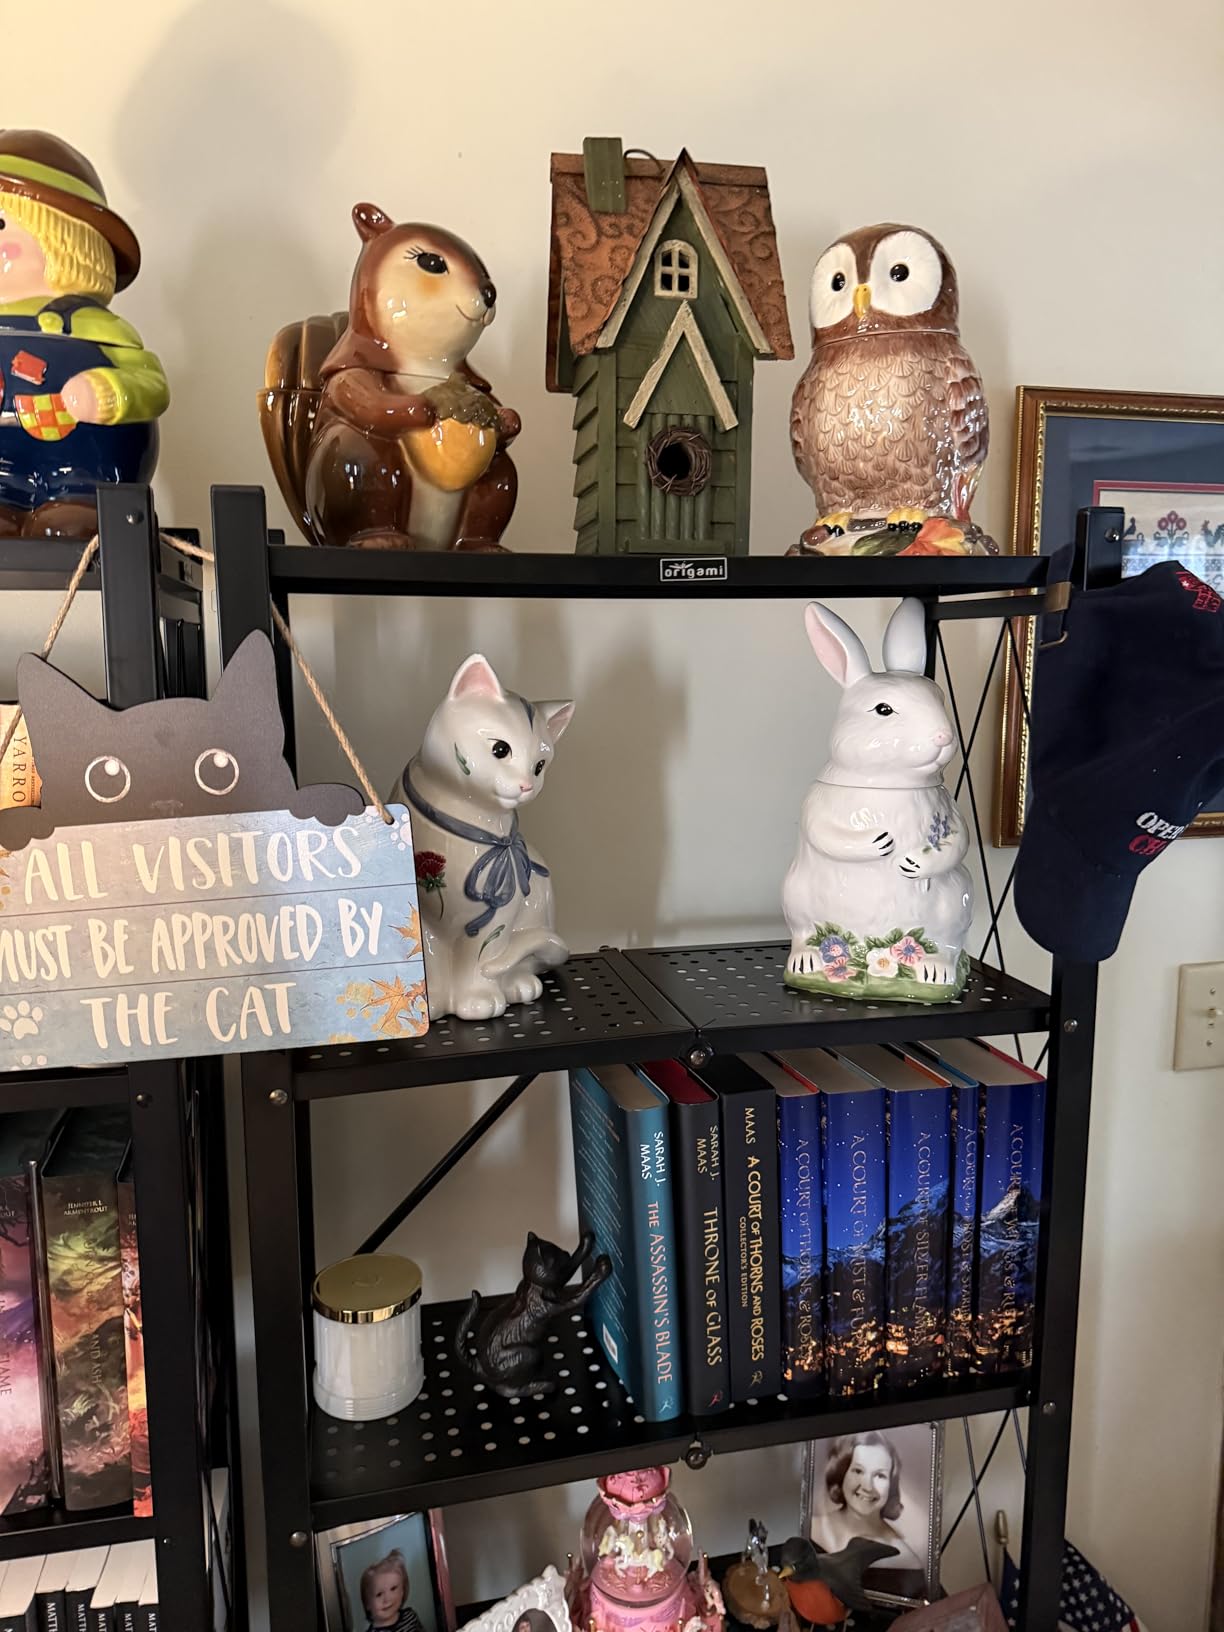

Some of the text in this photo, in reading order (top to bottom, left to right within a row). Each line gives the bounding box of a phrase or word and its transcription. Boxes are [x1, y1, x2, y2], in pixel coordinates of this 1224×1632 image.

[664, 562, 724, 579] origami
[25, 826, 362, 905] ALL VISITORS
[88, 918, 135, 979] BE
[151, 905, 323, 974] APPROVED
[338, 898, 383, 958] BY
[80, 982, 297, 1049] THE CAT
[709, 1125, 720, 1181] SARAH J.
[744, 1107, 756, 1144] MAAS
[640, 1144, 653, 1180] MAAS
[653, 1131, 666, 1187] SARAH J.
[696, 1138, 708, 1174] MAAS
[797, 1152, 811, 1209] COURT
[850, 1150, 867, 1217] COURT
[916, 1146, 931, 1206] COURT
[703, 1207, 722, 1366] THRONE OF GLASS
[739, 1216, 750, 1308] COLLECTOR'S EDITION
[747, 1155, 765, 1361] A COURT OF THORNS AND ROSES
[797, 1228, 812, 1293] THORNS
[914, 1232, 930, 1283] SILVER
[647, 1200, 673, 1384] THE ASSASSIN'S BLADE
[91, 1363, 103, 1385] ASH
